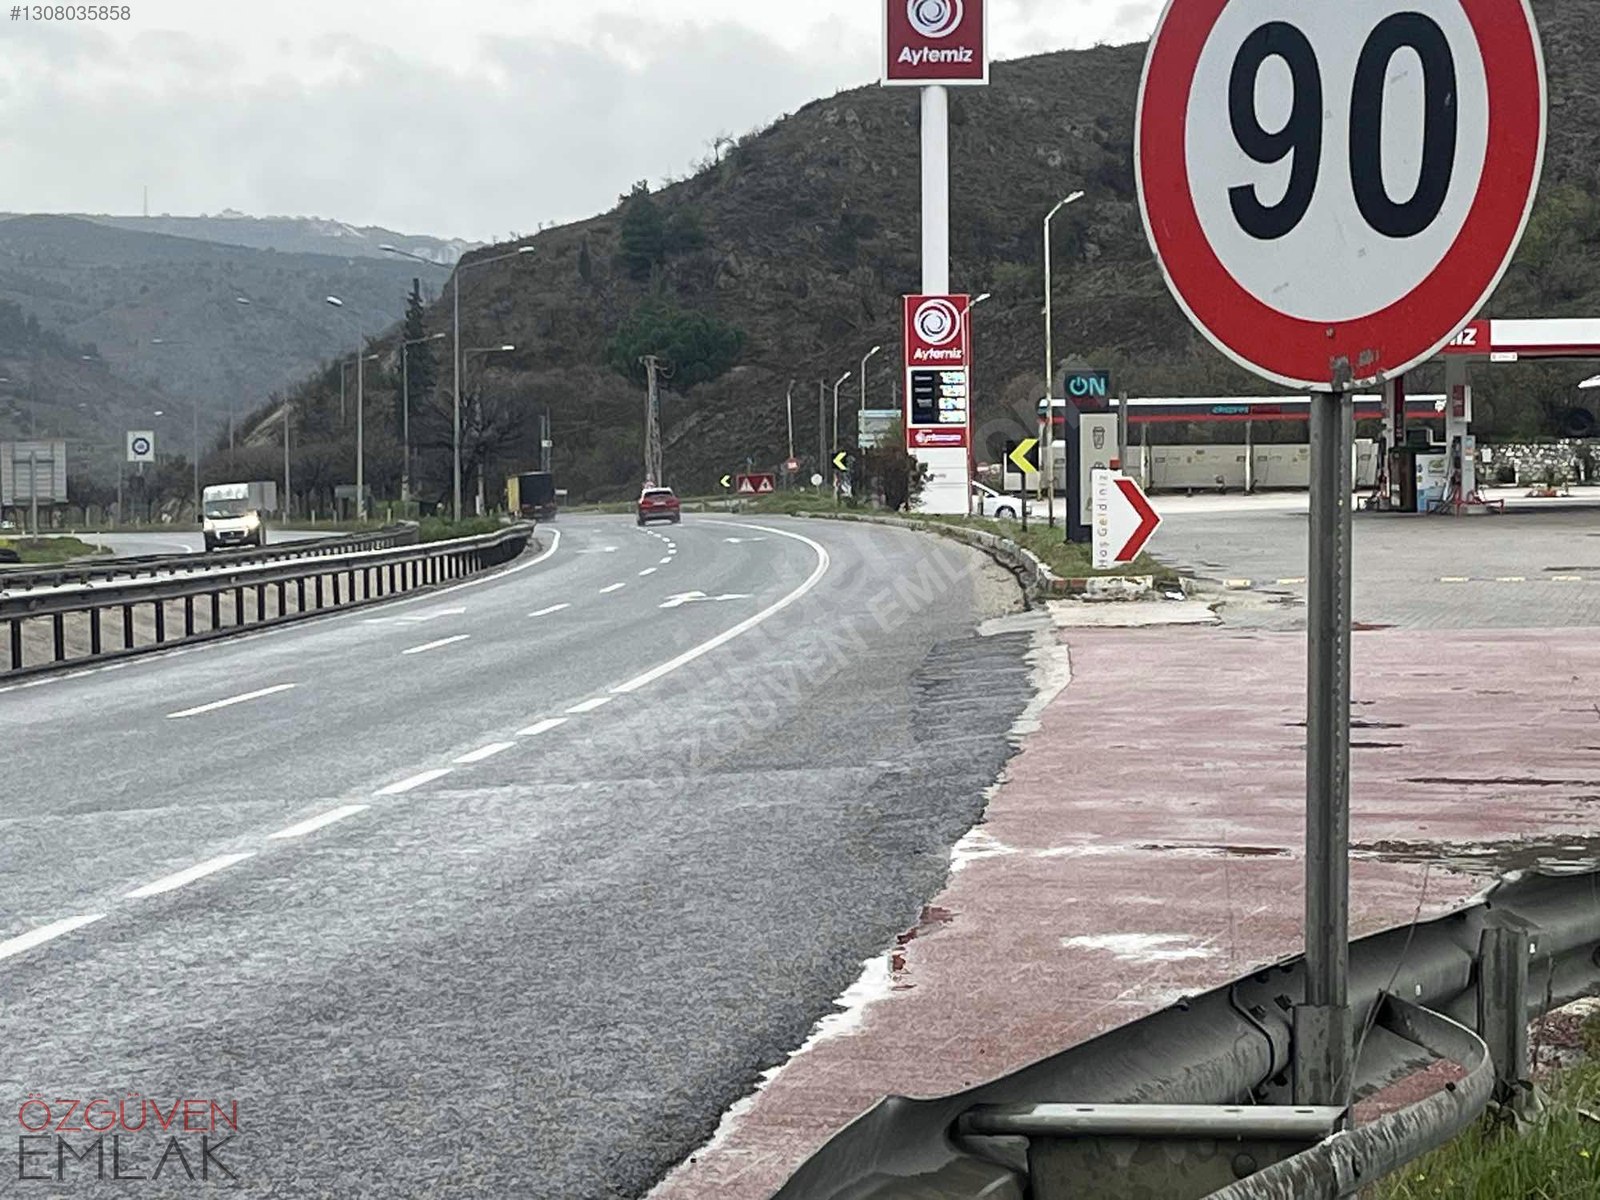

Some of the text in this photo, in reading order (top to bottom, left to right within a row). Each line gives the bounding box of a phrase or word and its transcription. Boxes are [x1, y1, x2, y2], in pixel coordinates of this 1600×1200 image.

[898, 46, 973, 66] Aytemiz
[1228, 11, 1457, 240] 90
[1069, 376, 1106, 397] ON
